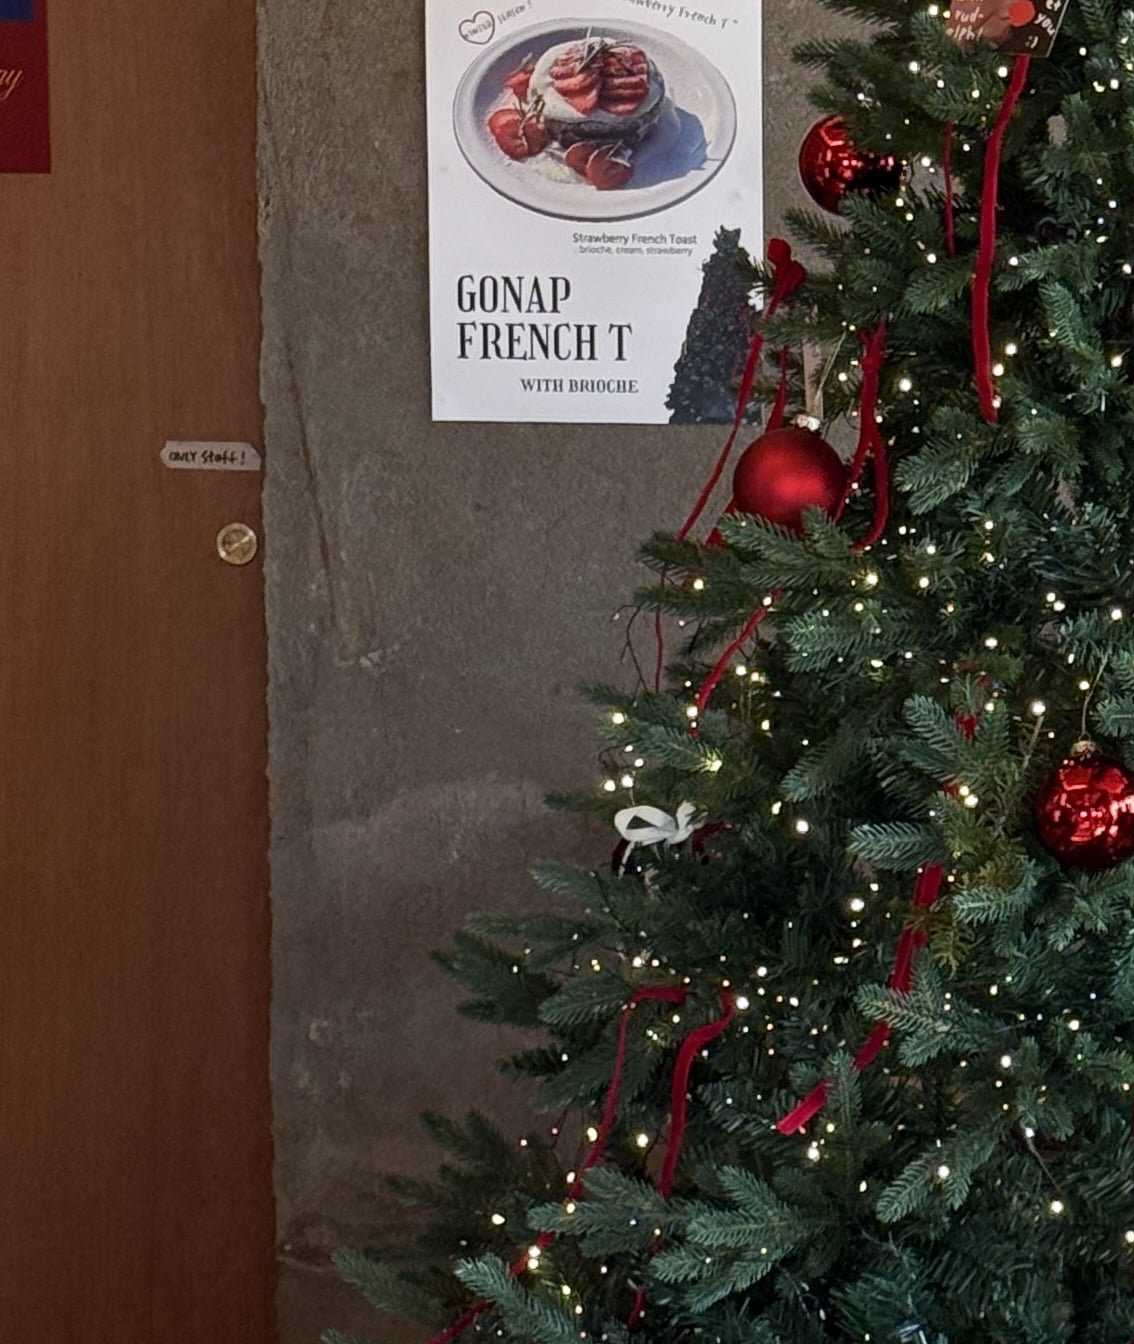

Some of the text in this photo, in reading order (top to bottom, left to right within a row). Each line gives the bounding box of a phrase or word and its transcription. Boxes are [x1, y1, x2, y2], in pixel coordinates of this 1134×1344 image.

[679, 6, 717, 25] French
[1034, 13, 1055, 36] you
[572, 232, 698, 245] Strawberry French Toast
[646, 246, 693, 256] strawberry
[457, 275, 571, 313] GONAP
[456, 321, 633, 361] FRENCH T
[520, 378, 639, 393] WITH BRIOCHE
